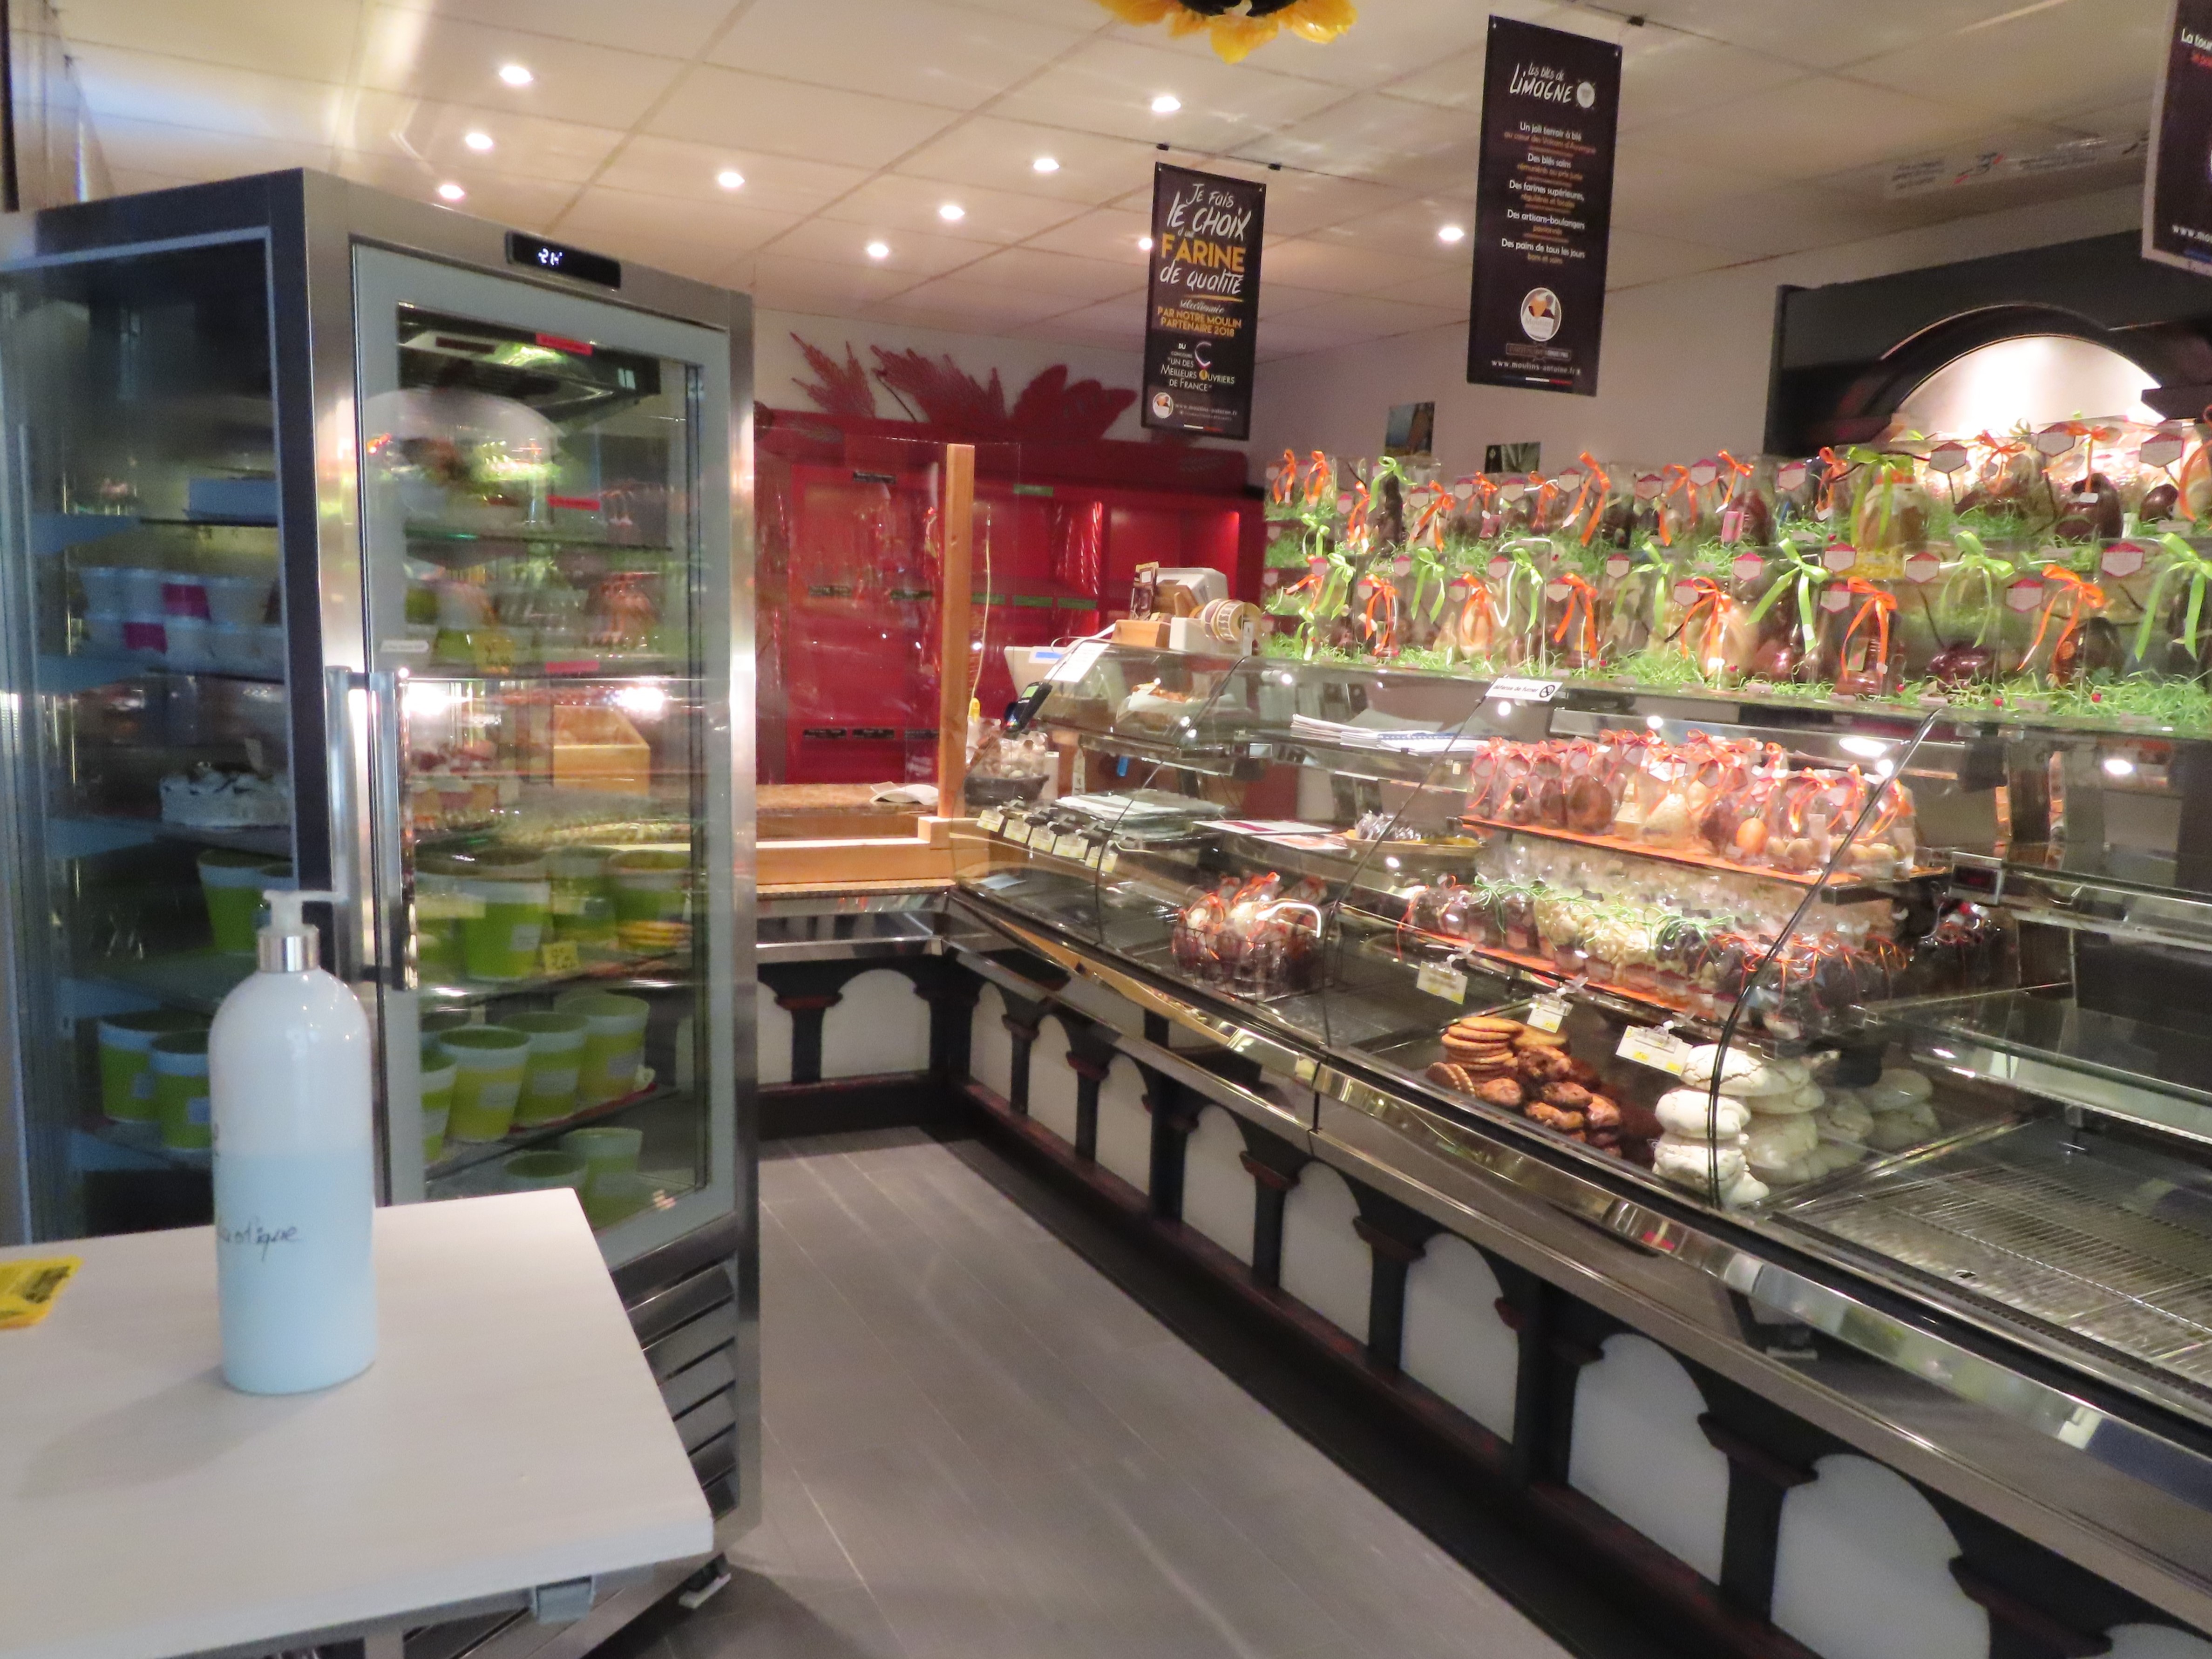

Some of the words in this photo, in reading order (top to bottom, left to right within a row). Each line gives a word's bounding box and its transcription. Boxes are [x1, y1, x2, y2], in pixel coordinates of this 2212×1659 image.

[2181, 27, 2194, 44] La
[1520, 122, 1530, 131] Un
[1532, 123, 1542, 134] joli
[1527, 153, 1540, 163] Des
[1541, 155, 1555, 166] blés
[1509, 179, 1522, 190] Des
[1524, 182, 1546, 194] farines
[1507, 209, 1520, 219] Des
[1161, 233, 1247, 274] FARINE
[1501, 238, 1514, 248] Des
[1515, 241, 1534, 251] pains
[1535, 243, 1545, 252] de
[1546, 245, 1560, 254] tous
[1561, 246, 1570, 256] les
[1570, 249, 1586, 259] jours
[1158, 306, 1174, 317] PAR
[1176, 310, 1205, 322] NOTRE
[1207, 315, 1242, 328] MOULIN
[1161, 317, 1212, 333] PARTENAIRE
[1182, 359, 1194, 368] DES
